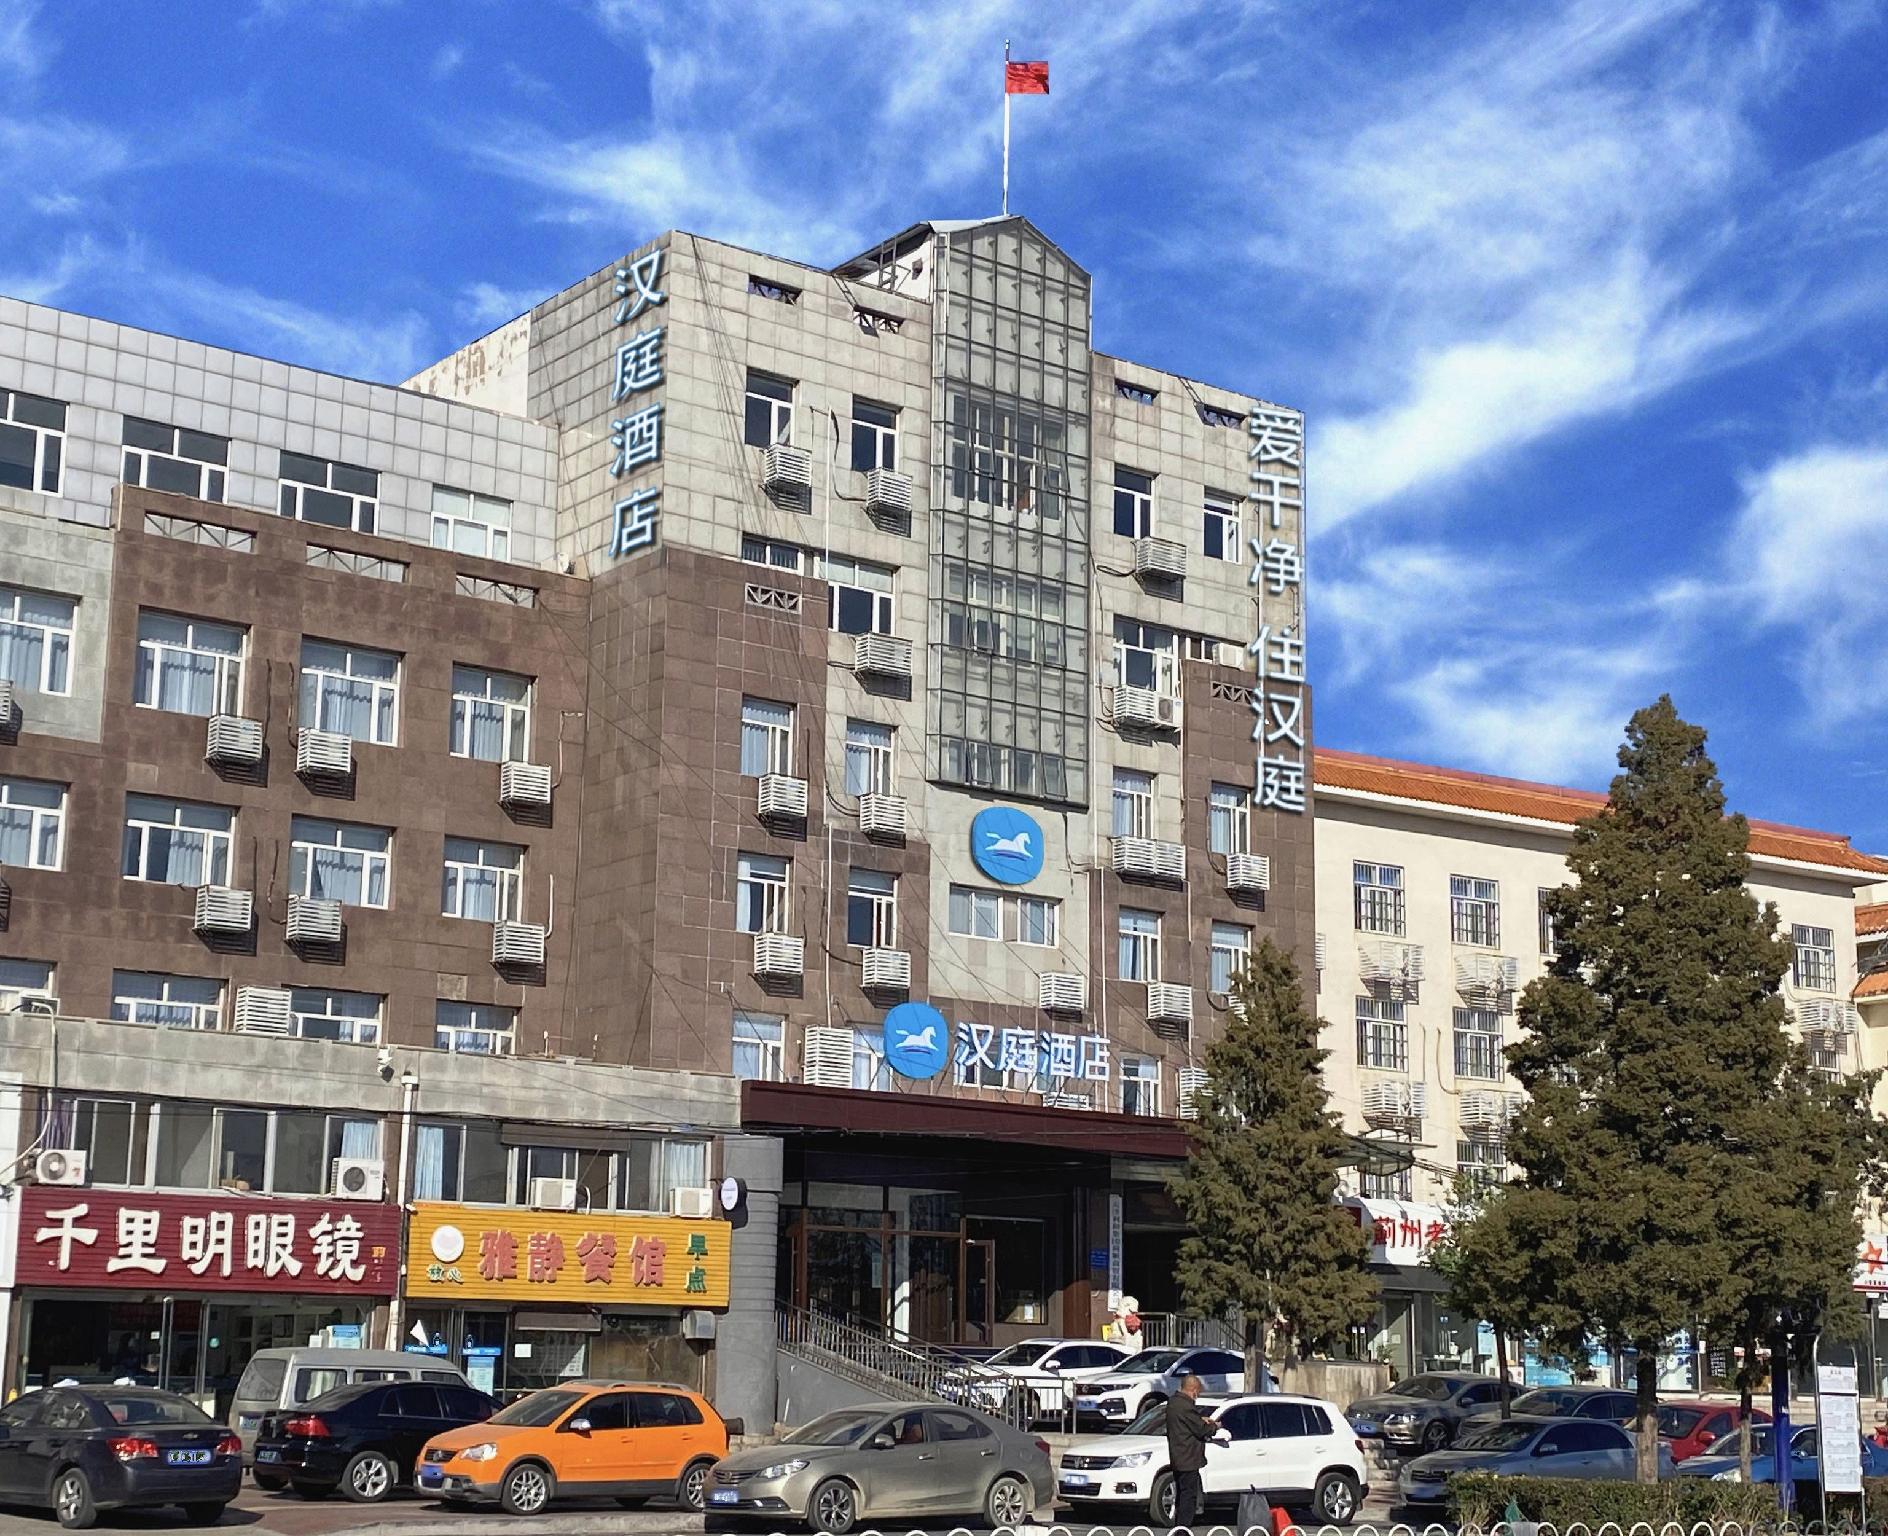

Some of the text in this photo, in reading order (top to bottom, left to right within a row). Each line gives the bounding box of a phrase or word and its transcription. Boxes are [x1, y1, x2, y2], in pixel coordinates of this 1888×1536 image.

[609, 249, 665, 557] 汉庭酒店
[1248, 407, 1306, 812] 爱干净 住汉庭
[954, 1022, 1111, 1081] 汉庭酒店
[35, 1203, 367, 1282] 千里明眼镜
[478, 1228, 668, 1288] 雅静餐馆
[685, 1232, 709, 1294] 早点
